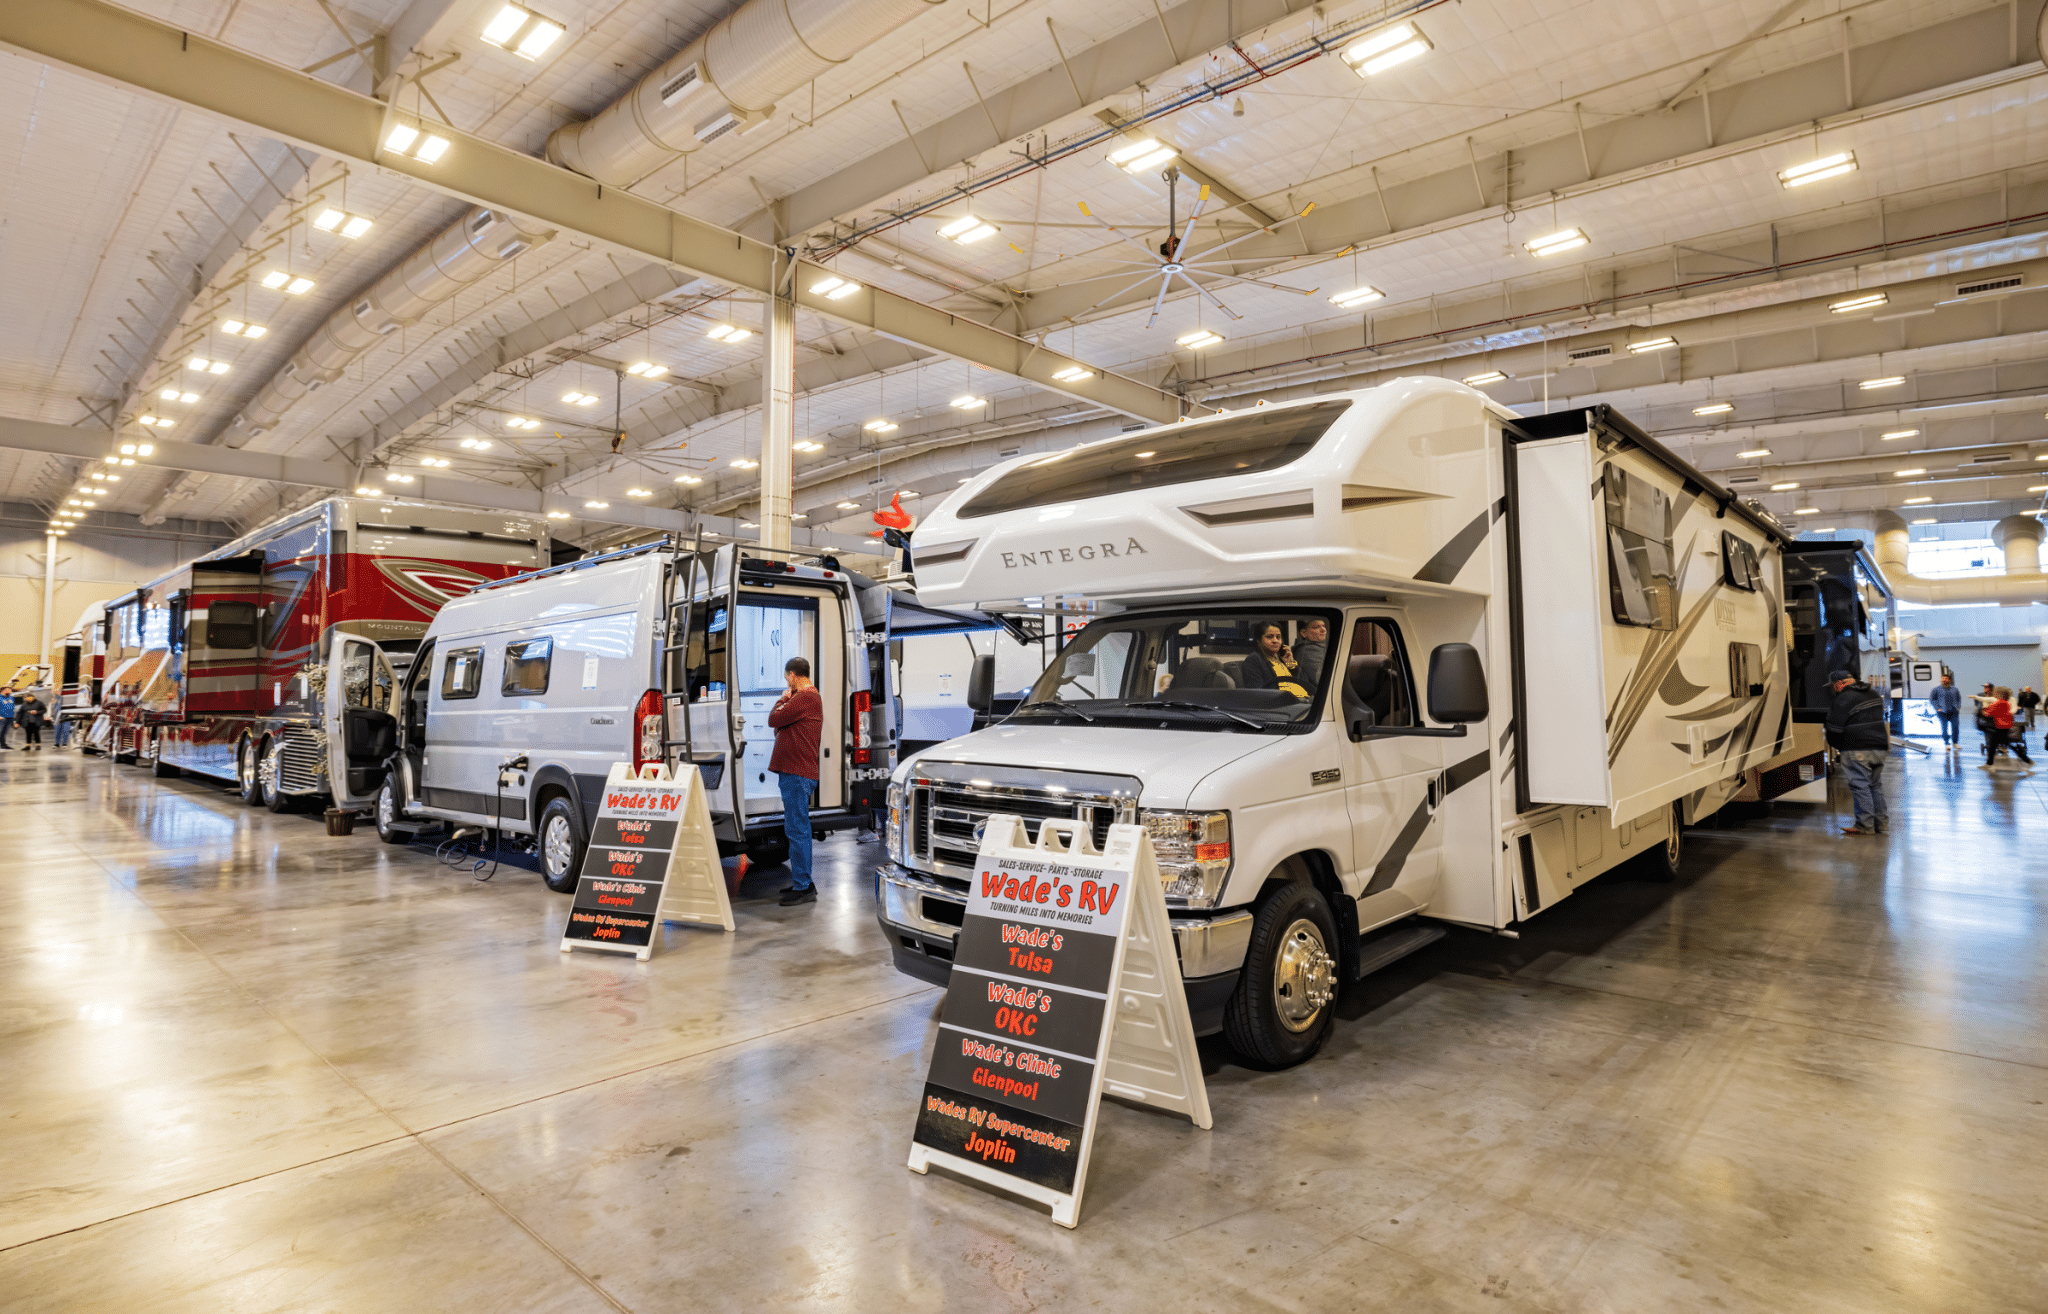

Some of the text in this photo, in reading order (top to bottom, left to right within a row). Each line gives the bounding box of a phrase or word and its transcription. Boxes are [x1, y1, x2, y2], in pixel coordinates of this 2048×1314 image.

[1000, 537, 1149, 569] ENTEGRA
[367, 623, 421, 631] MOUNTAIN
[607, 793, 682, 812] Wade's RV
[617, 820, 651, 832] Wade's
[621, 831, 645, 844] Tulsa
[608, 850, 643, 863] Wade's
[611, 862, 635, 876] OKC
[1048, 865, 1069, 876] PARTS
[592, 881, 646, 895] Wade's Clinic
[982, 871, 1120, 915] Wade's RV
[597, 894, 634, 908] Glenpool
[990, 901, 1093, 925] TURNING MILES INTO MEMORIES
[592, 926, 621, 940] Joplin
[1002, 923, 1064, 951] Wade's
[1009, 946, 1053, 974] Tulsa
[988, 981, 1052, 1013] Wade's
[994, 1006, 1038, 1036] OKC
[961, 1038, 1061, 1079] Wade's Clinic
[972, 1066, 1039, 1101] Glenpool
[927, 1095, 1070, 1152] Wades RV Supercenter
[964, 1131, 1016, 1164] Joplin
